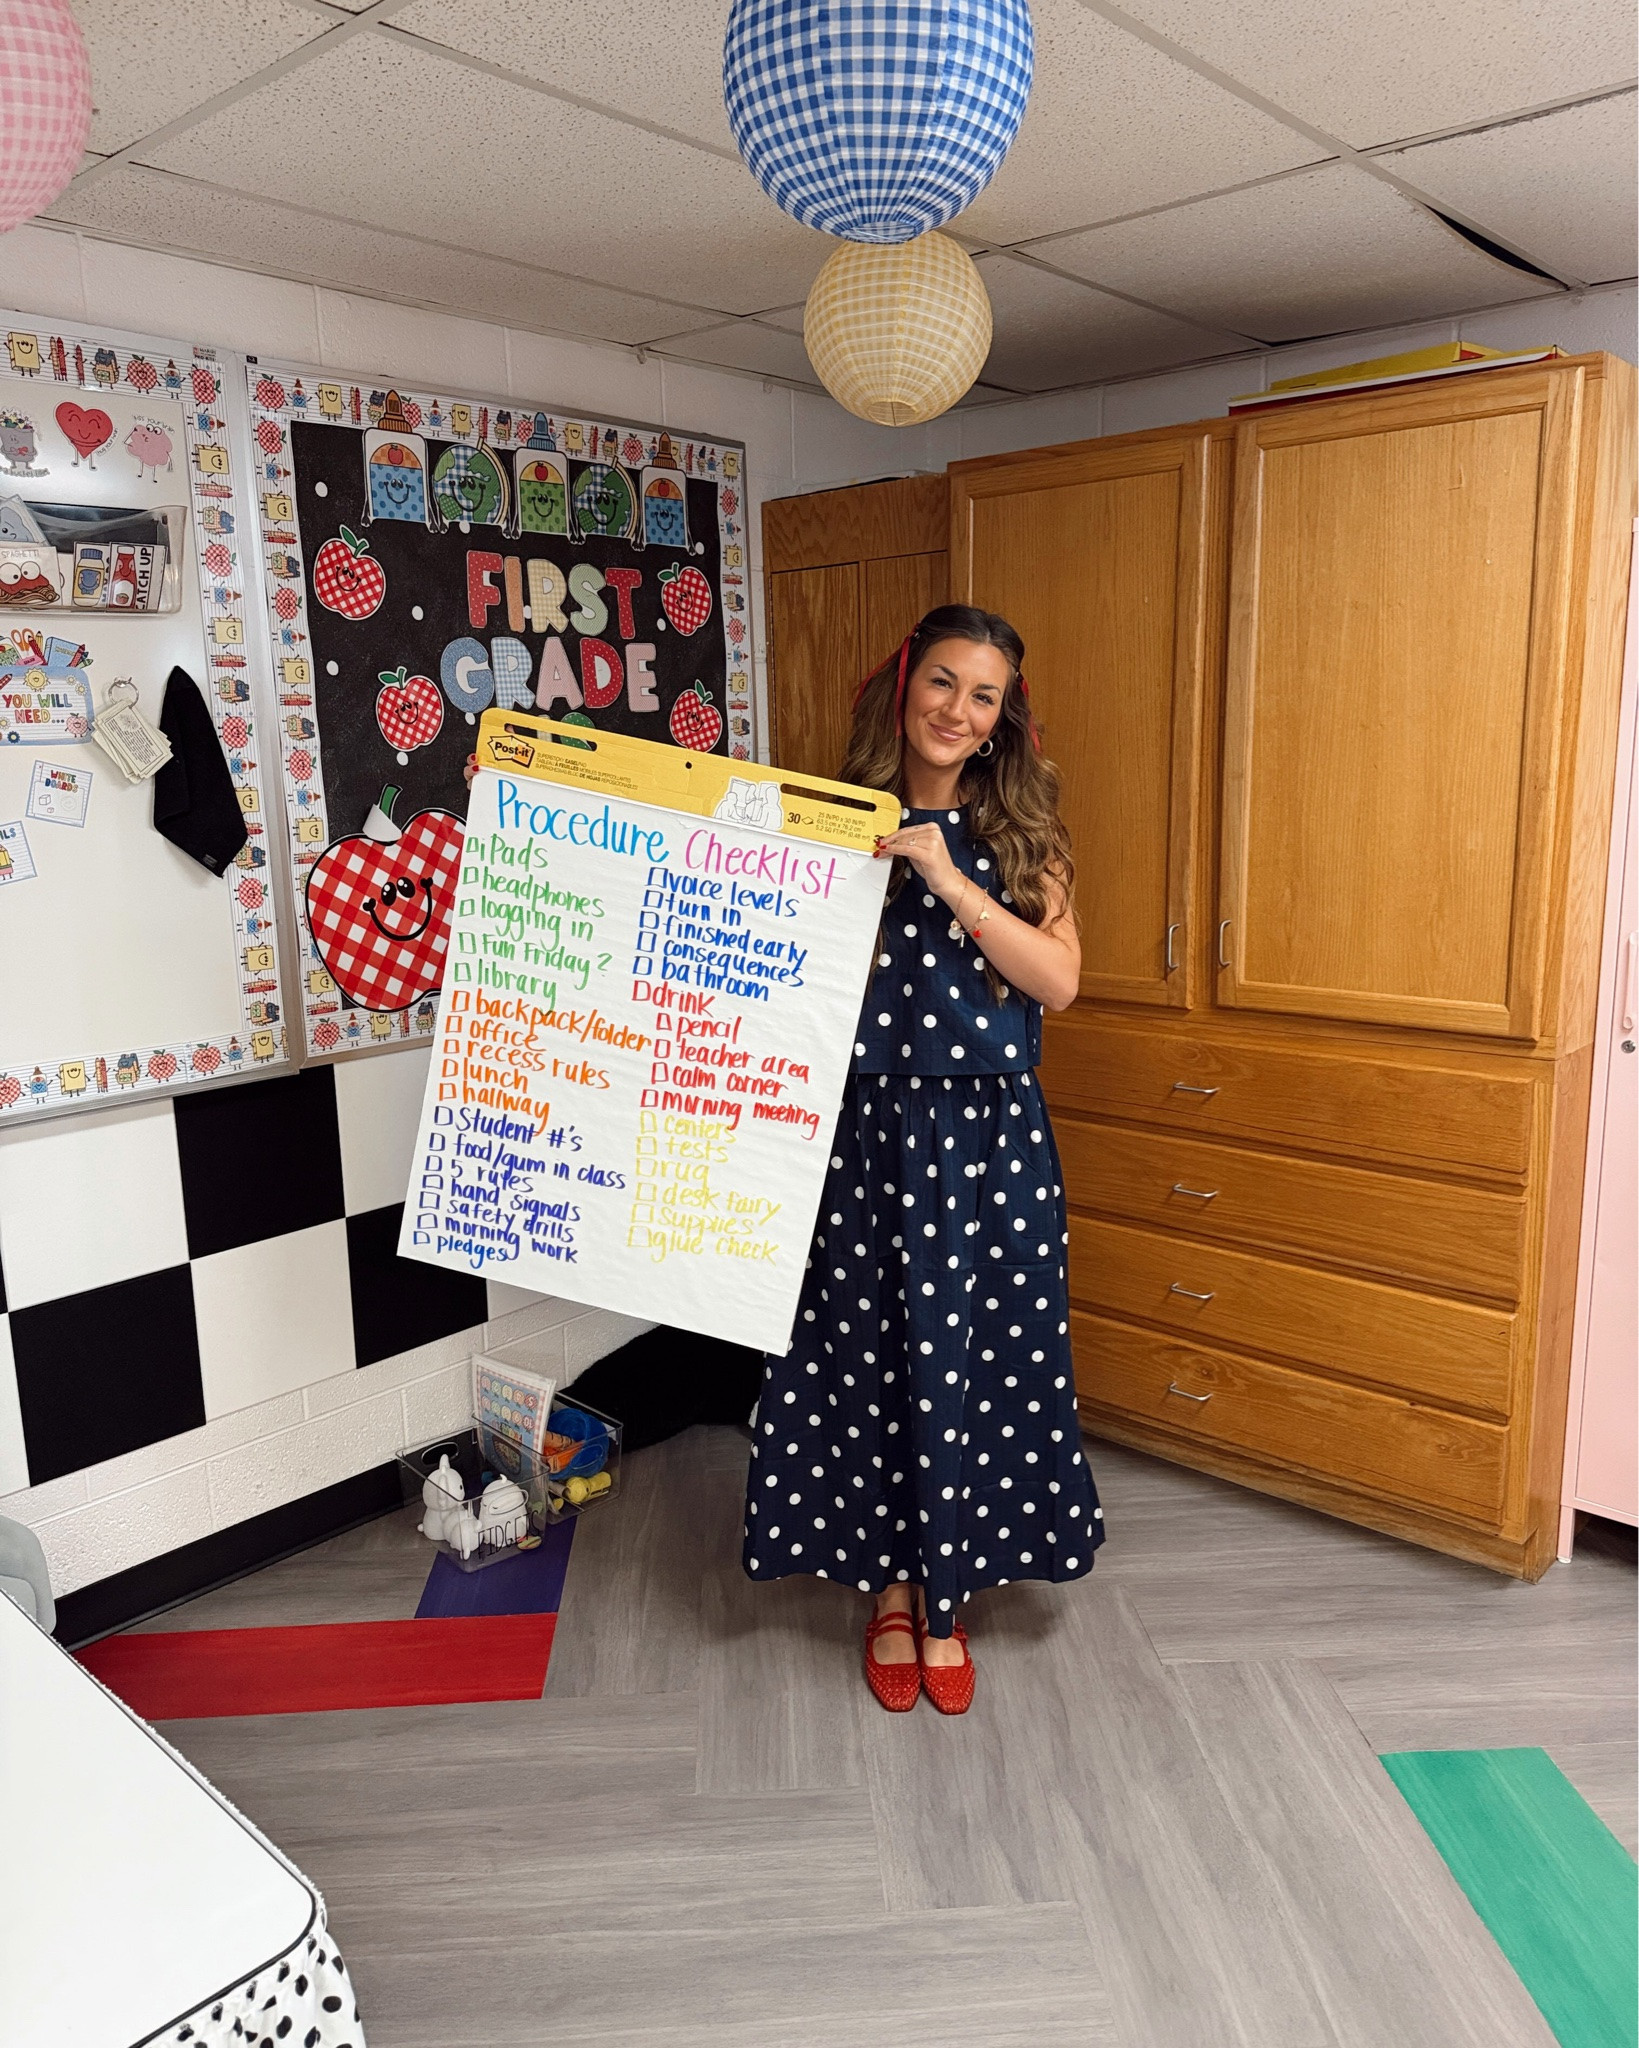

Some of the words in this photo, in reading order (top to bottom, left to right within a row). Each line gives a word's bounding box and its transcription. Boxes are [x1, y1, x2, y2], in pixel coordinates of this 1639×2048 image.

[140, 547, 152, 566] UP
[466, 550, 643, 640] FIRST
[440, 636, 660, 714] GRADE
[2, 693, 32, 708] YOU
[37, 693, 73, 708] WILL
[494, 741, 531, 758] Post-it
[44, 778, 79, 793] BOARDS
[50, 769, 77, 784] WHITE
[787, 812, 801, 824] 30
[818, 811, 826, 819] 25
[480, 833, 549, 871] iPads
[498, 779, 670, 863] Procedure
[685, 829, 847, 899] Checklist
[482, 865, 605, 918] headphones
[665, 893, 711, 922] turn
[722, 904, 742, 926] in
[669, 872, 724, 900] voice
[730, 881, 800, 918] levels
[481, 895, 562, 951] logging
[571, 918, 594, 942] in
[482, 933, 516, 961] Fun
[662, 914, 751, 954] finished
[753, 940, 808, 971] early
[663, 939, 805, 987] consequences
[477, 958, 557, 1017] library
[652, 981, 716, 1018] drink
[469, 1018, 547, 1052] office
[475, 988, 652, 1052] backpack/folder
[676, 1015, 742, 1045] pencil
[463, 1057, 529, 1094] lunch
[467, 1039, 546, 1072] recess
[552, 1057, 611, 1089] rules
[677, 1037, 756, 1069] teacher
[761, 1056, 810, 1084] area
[672, 1065, 716, 1090] calm
[726, 1072, 789, 1098] corner
[462, 1080, 550, 1137] hallway
[661, 1090, 743, 1131] morning
[753, 1101, 821, 1141] meeting
[663, 1114, 737, 1144] centers
[665, 1135, 729, 1164] tests
[451, 1158, 464, 1179] 5
[477, 1166, 534, 1193] rules
[553, 1158, 570, 1181] in
[577, 1164, 627, 1189] class
[661, 1160, 710, 1195] rug
[446, 1199, 516, 1232] safety
[523, 1214, 575, 1243] drills
[450, 1178, 500, 1206] hand
[510, 1194, 582, 1227] signals
[657, 1206, 755, 1236] supplies
[662, 1182, 721, 1211] desk
[726, 1191, 782, 1226] fairy
[436, 1234, 509, 1269] pledges
[445, 1216, 520, 1261] morning
[531, 1238, 579, 1264] work
[651, 1230, 704, 1263] glue
[715, 1237, 780, 1267] check
[477, 1510, 541, 1560] FIDGETS
